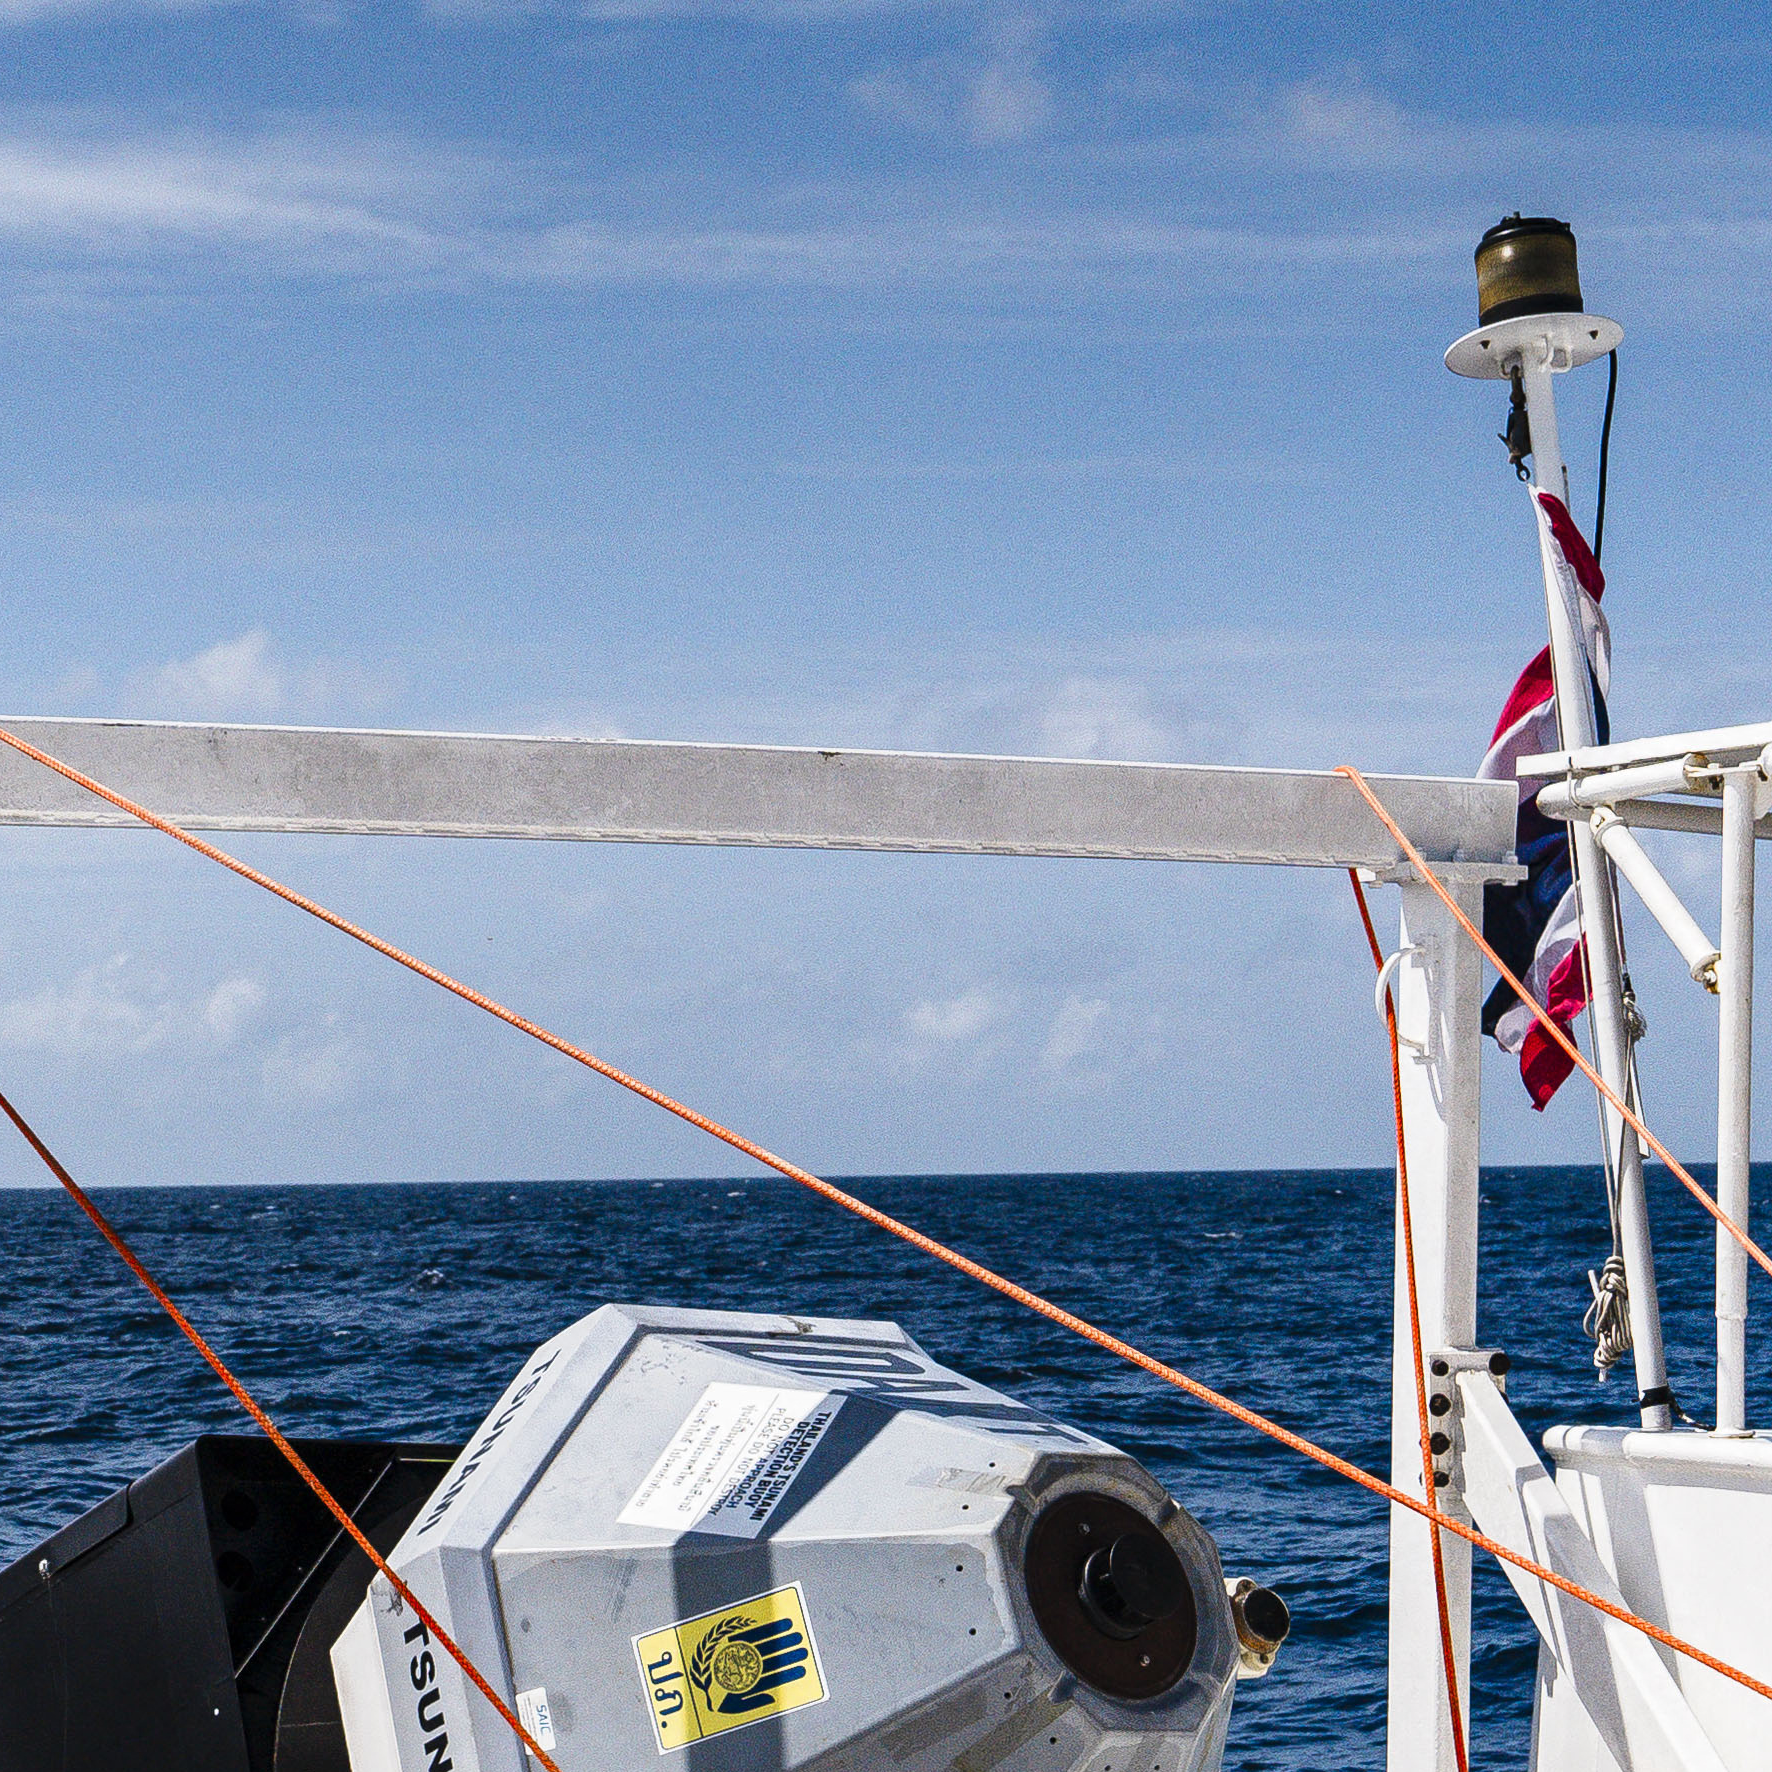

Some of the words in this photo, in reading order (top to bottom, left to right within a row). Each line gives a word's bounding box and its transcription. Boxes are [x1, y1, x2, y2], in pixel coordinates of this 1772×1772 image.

[760, 1407, 787, 1439] PLEASE
[777, 1417, 795, 1432] DO
[416, 1349, 561, 1536] TSUNAMI
[747, 1441, 764, 1455] DO
[766, 1434, 785, 1454] NOT
[768, 1421, 810, 1476] DETECTION
[781, 1411, 831, 1471] THAILAND'S
[733, 1458, 753, 1475] NOT
[707, 1477, 742, 1516] DESTROY
[725, 1457, 770, 1509] APPROACH
[744, 1477, 774, 1508] BUOY
[748, 1473, 787, 1521] TSUNAMI
[536, 1704, 551, 1735] SAIC
